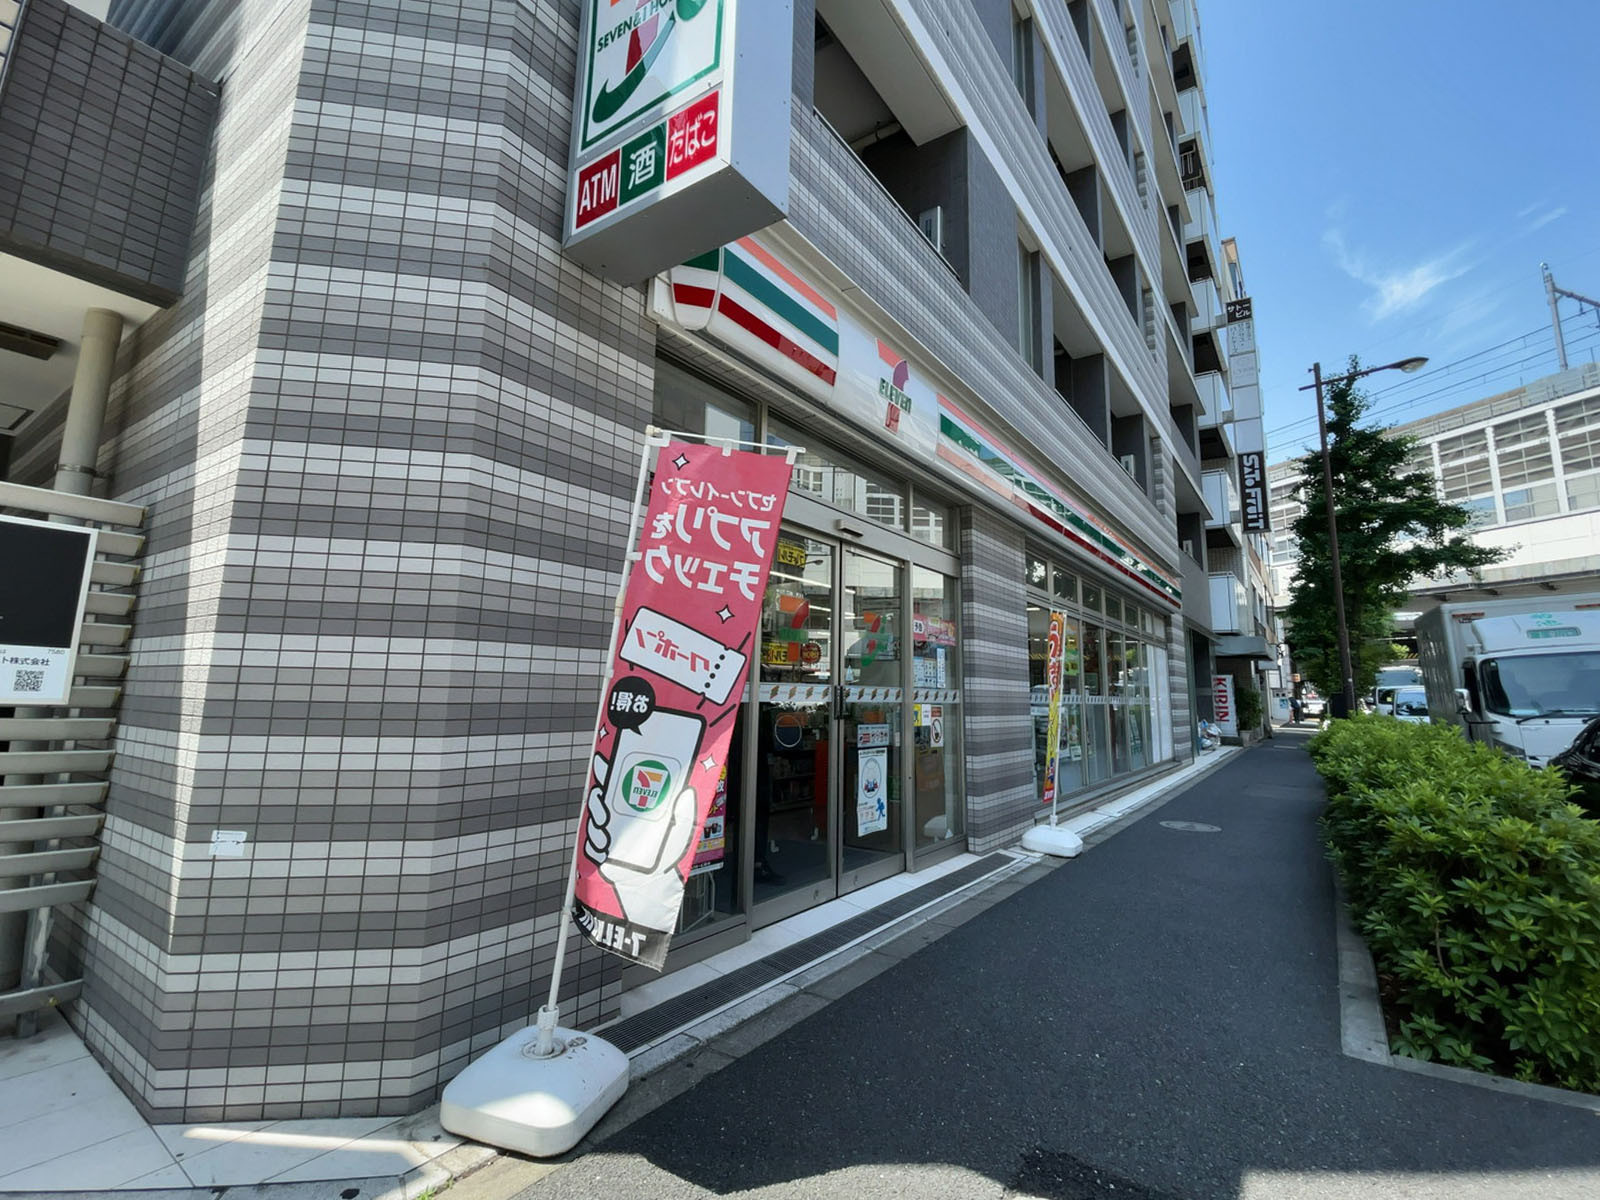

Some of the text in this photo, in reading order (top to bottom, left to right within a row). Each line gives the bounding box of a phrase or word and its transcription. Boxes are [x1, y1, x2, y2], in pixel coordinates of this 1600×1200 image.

[669, 110, 716, 168] たばこ
[628, 141, 657, 190] 酒
[579, 164, 617, 216] ATM
[1227, 303, 1250, 313] サトー
[1235, 309, 1251, 319] ビル
[2, 656, 50, 666] ト株式会社
[1214, 677, 1231, 722] KIRIN
